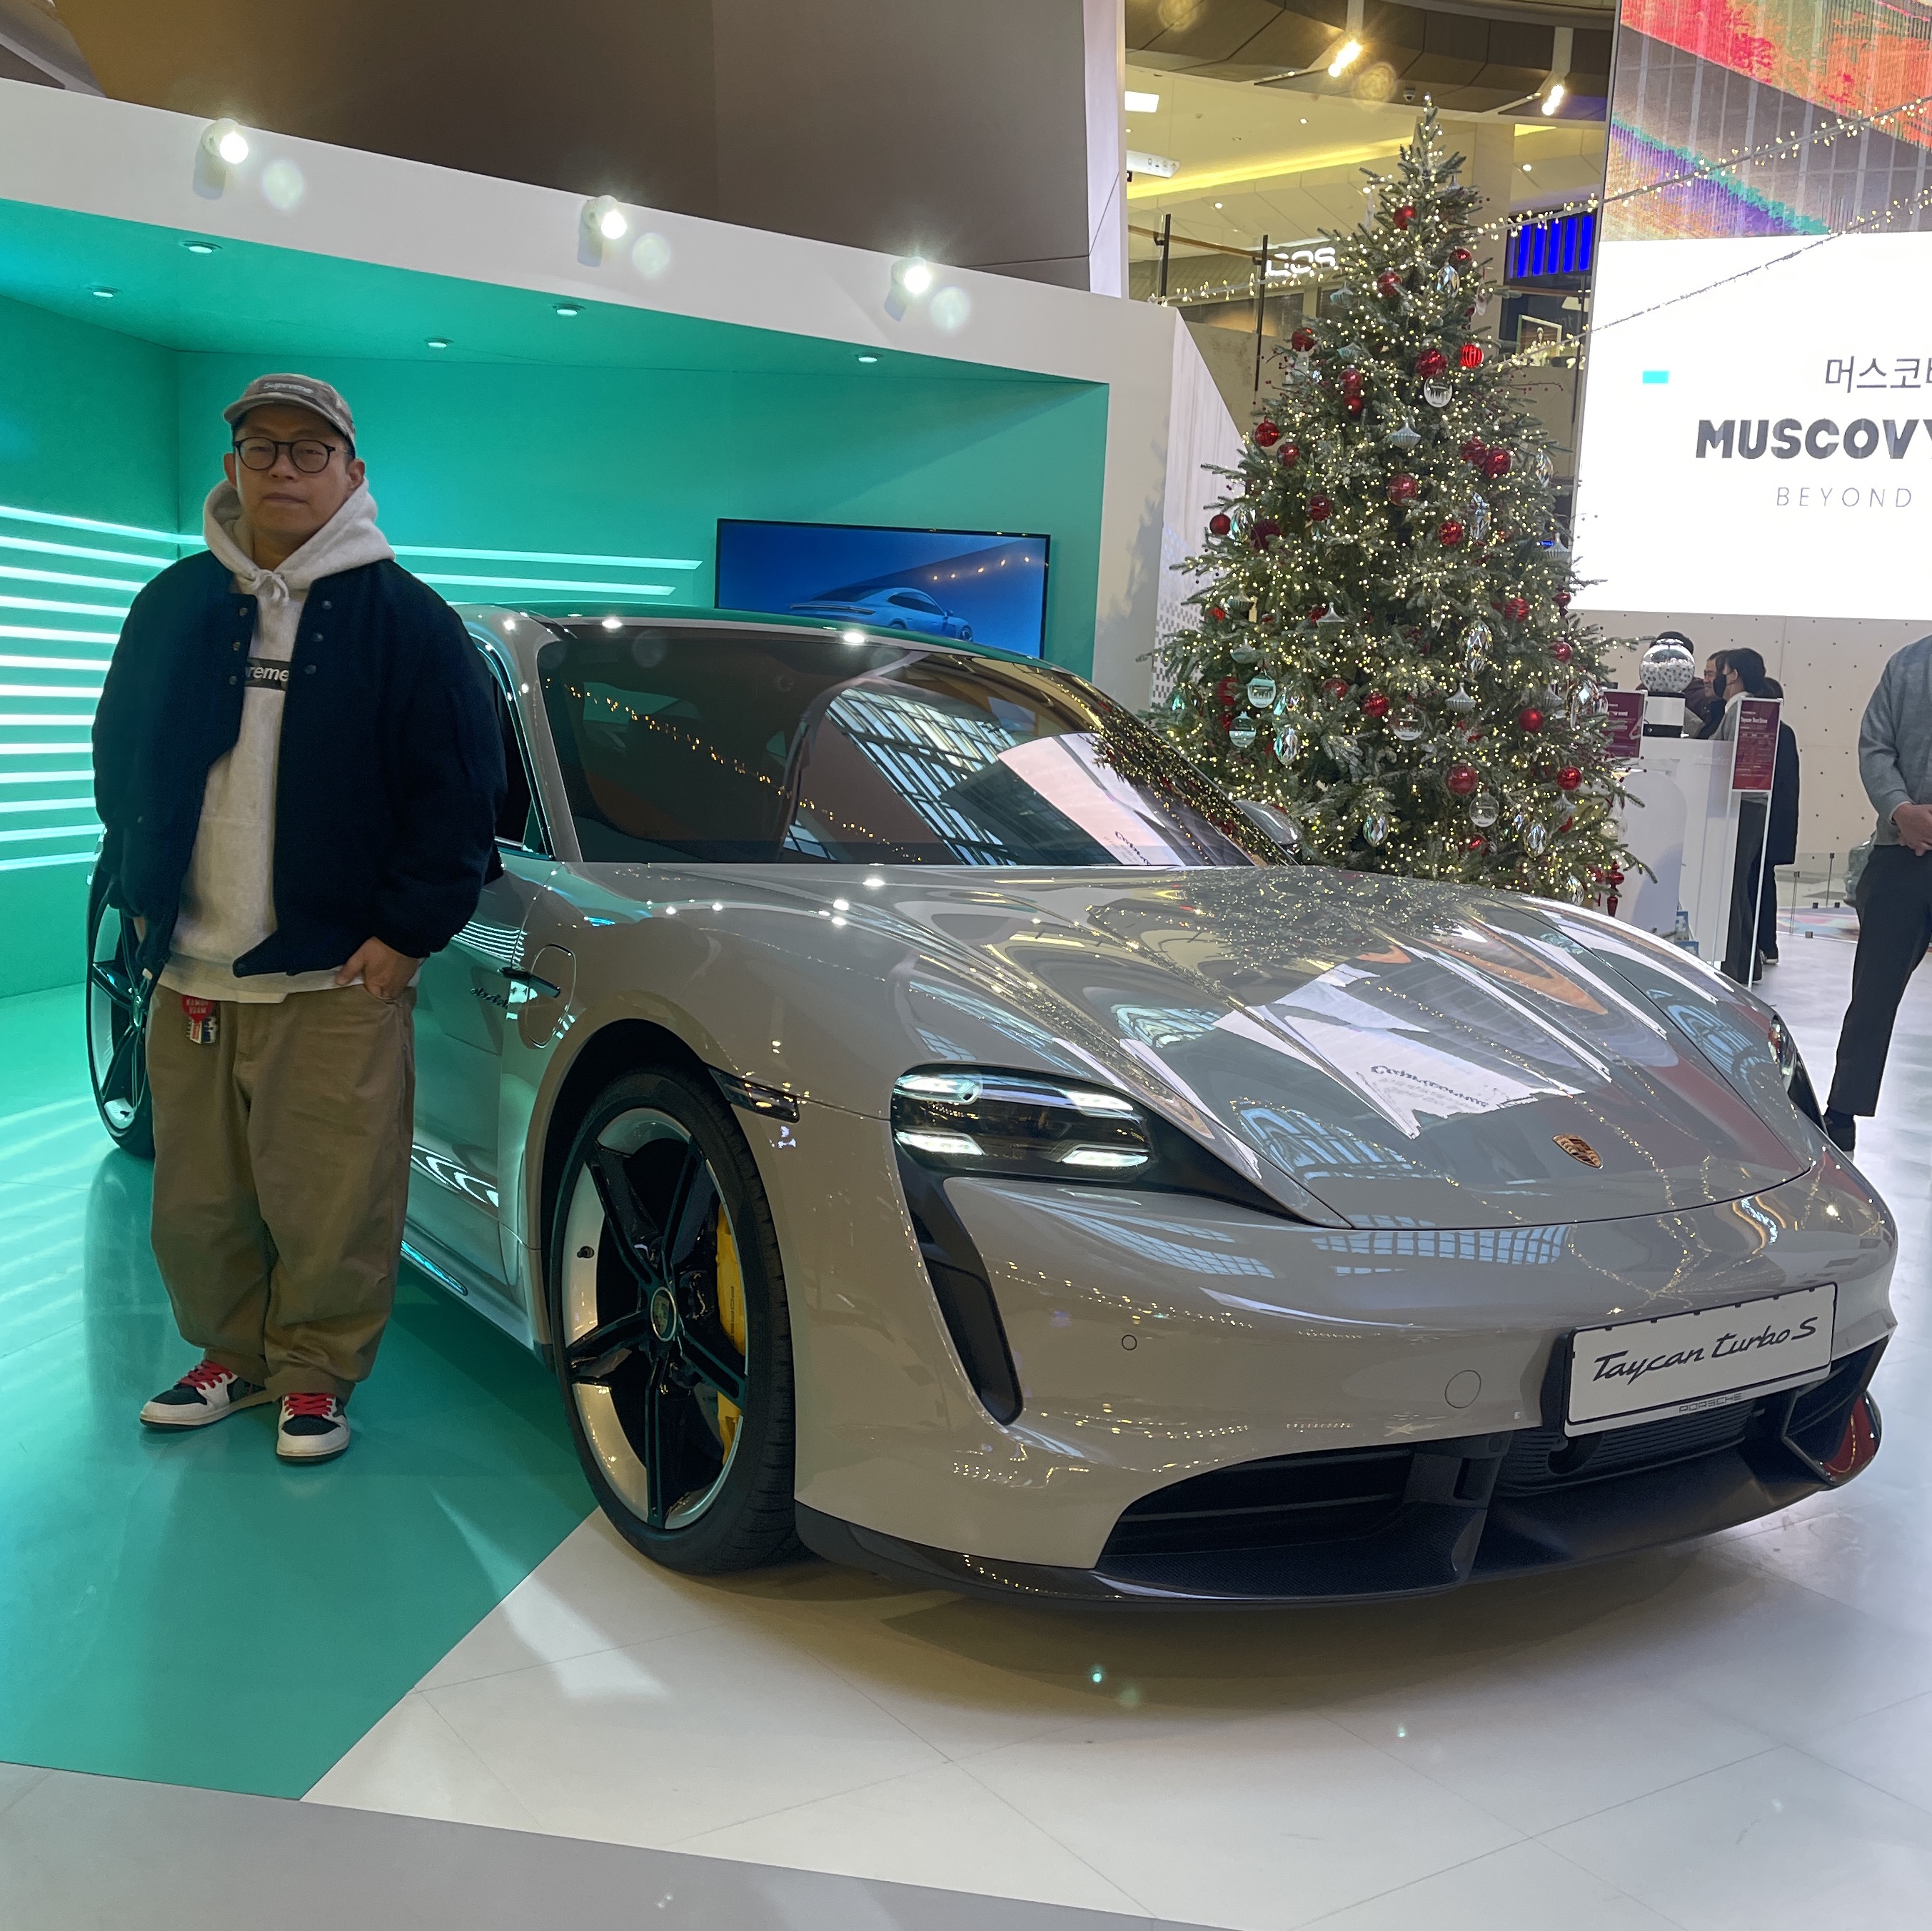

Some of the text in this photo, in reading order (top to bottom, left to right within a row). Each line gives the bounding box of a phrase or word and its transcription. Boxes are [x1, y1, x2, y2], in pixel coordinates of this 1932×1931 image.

[1776, 487, 1912, 508] BEYOND
[245, 667, 289, 682] reme
[1592, 1316, 1818, 1386] Taycan turbo S
[1679, 1392, 1743, 1413] PORSCHE
